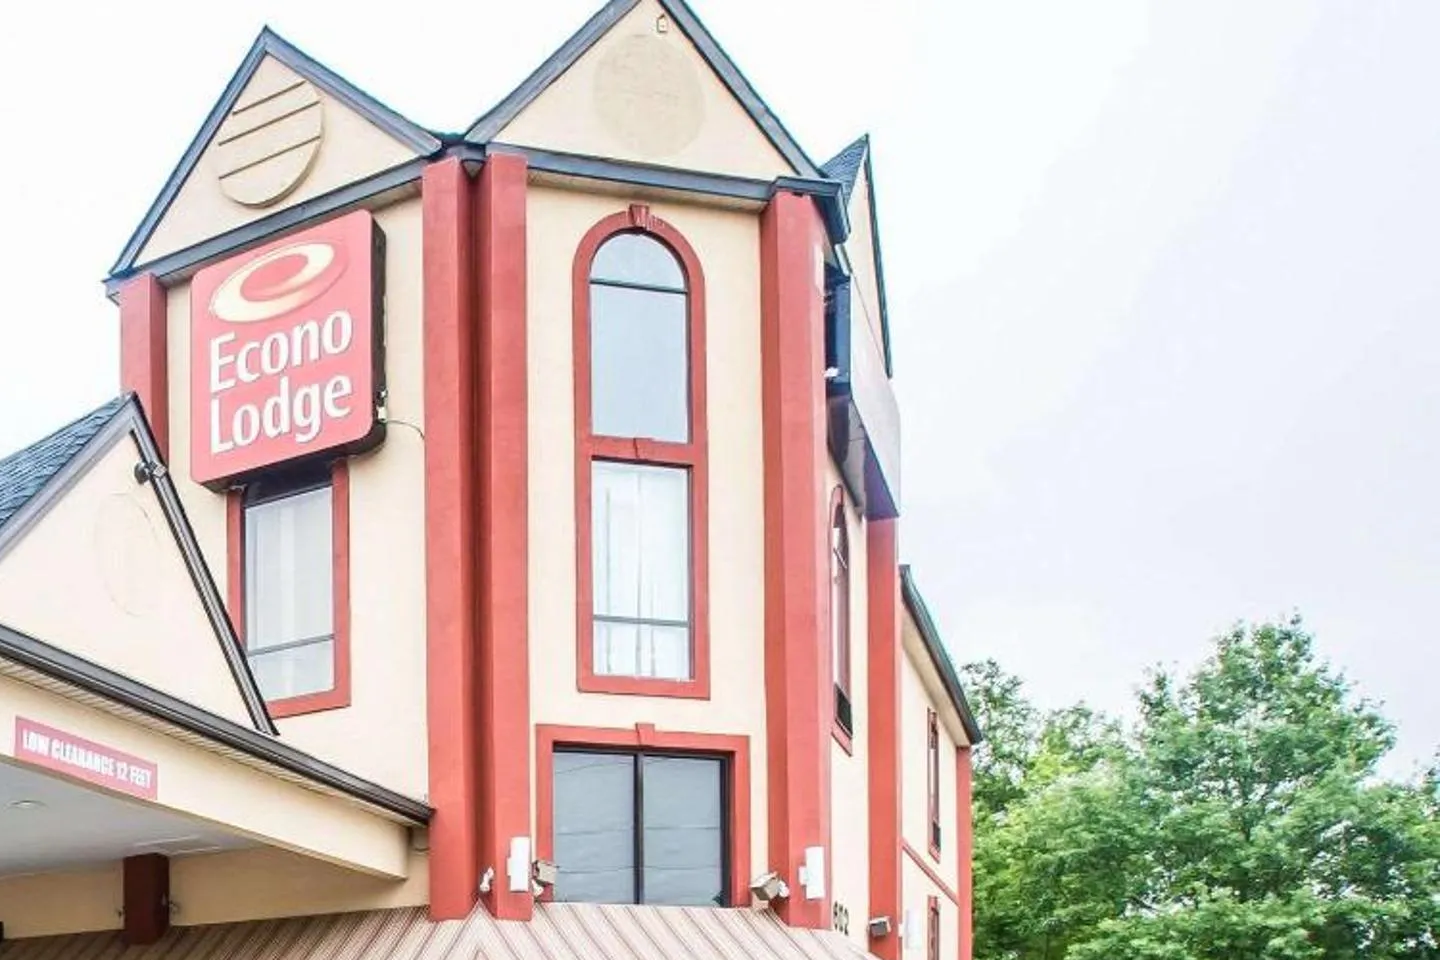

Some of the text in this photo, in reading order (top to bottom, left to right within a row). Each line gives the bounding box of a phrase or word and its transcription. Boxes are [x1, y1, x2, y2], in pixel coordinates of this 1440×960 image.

[210, 310, 352, 393] Econo
[210, 375, 352, 455] Lodge
[22, 728, 153, 789] LOW CLEARANCE 12 FEET
